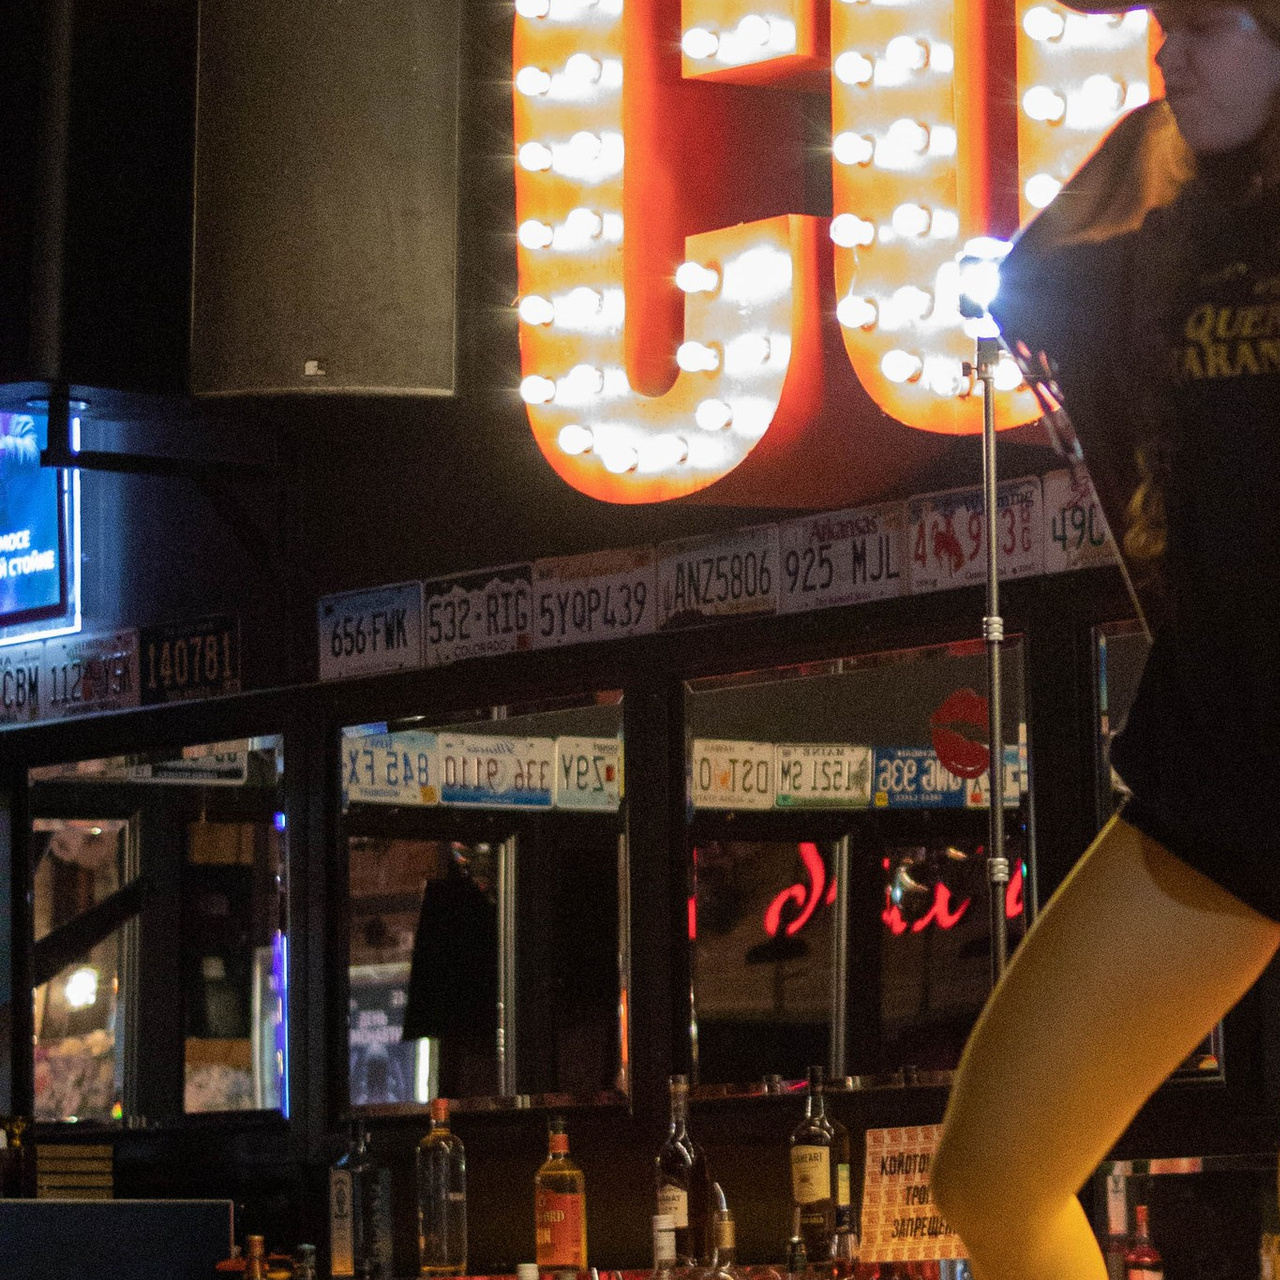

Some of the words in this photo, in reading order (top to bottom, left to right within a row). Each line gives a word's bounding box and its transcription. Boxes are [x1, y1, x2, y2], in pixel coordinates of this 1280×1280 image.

[810, 516, 878, 542] Arkansas
[675, 549, 772, 610] ANZ5806
[786, 543, 833, 594] 925
[852, 534, 900, 585] MJL
